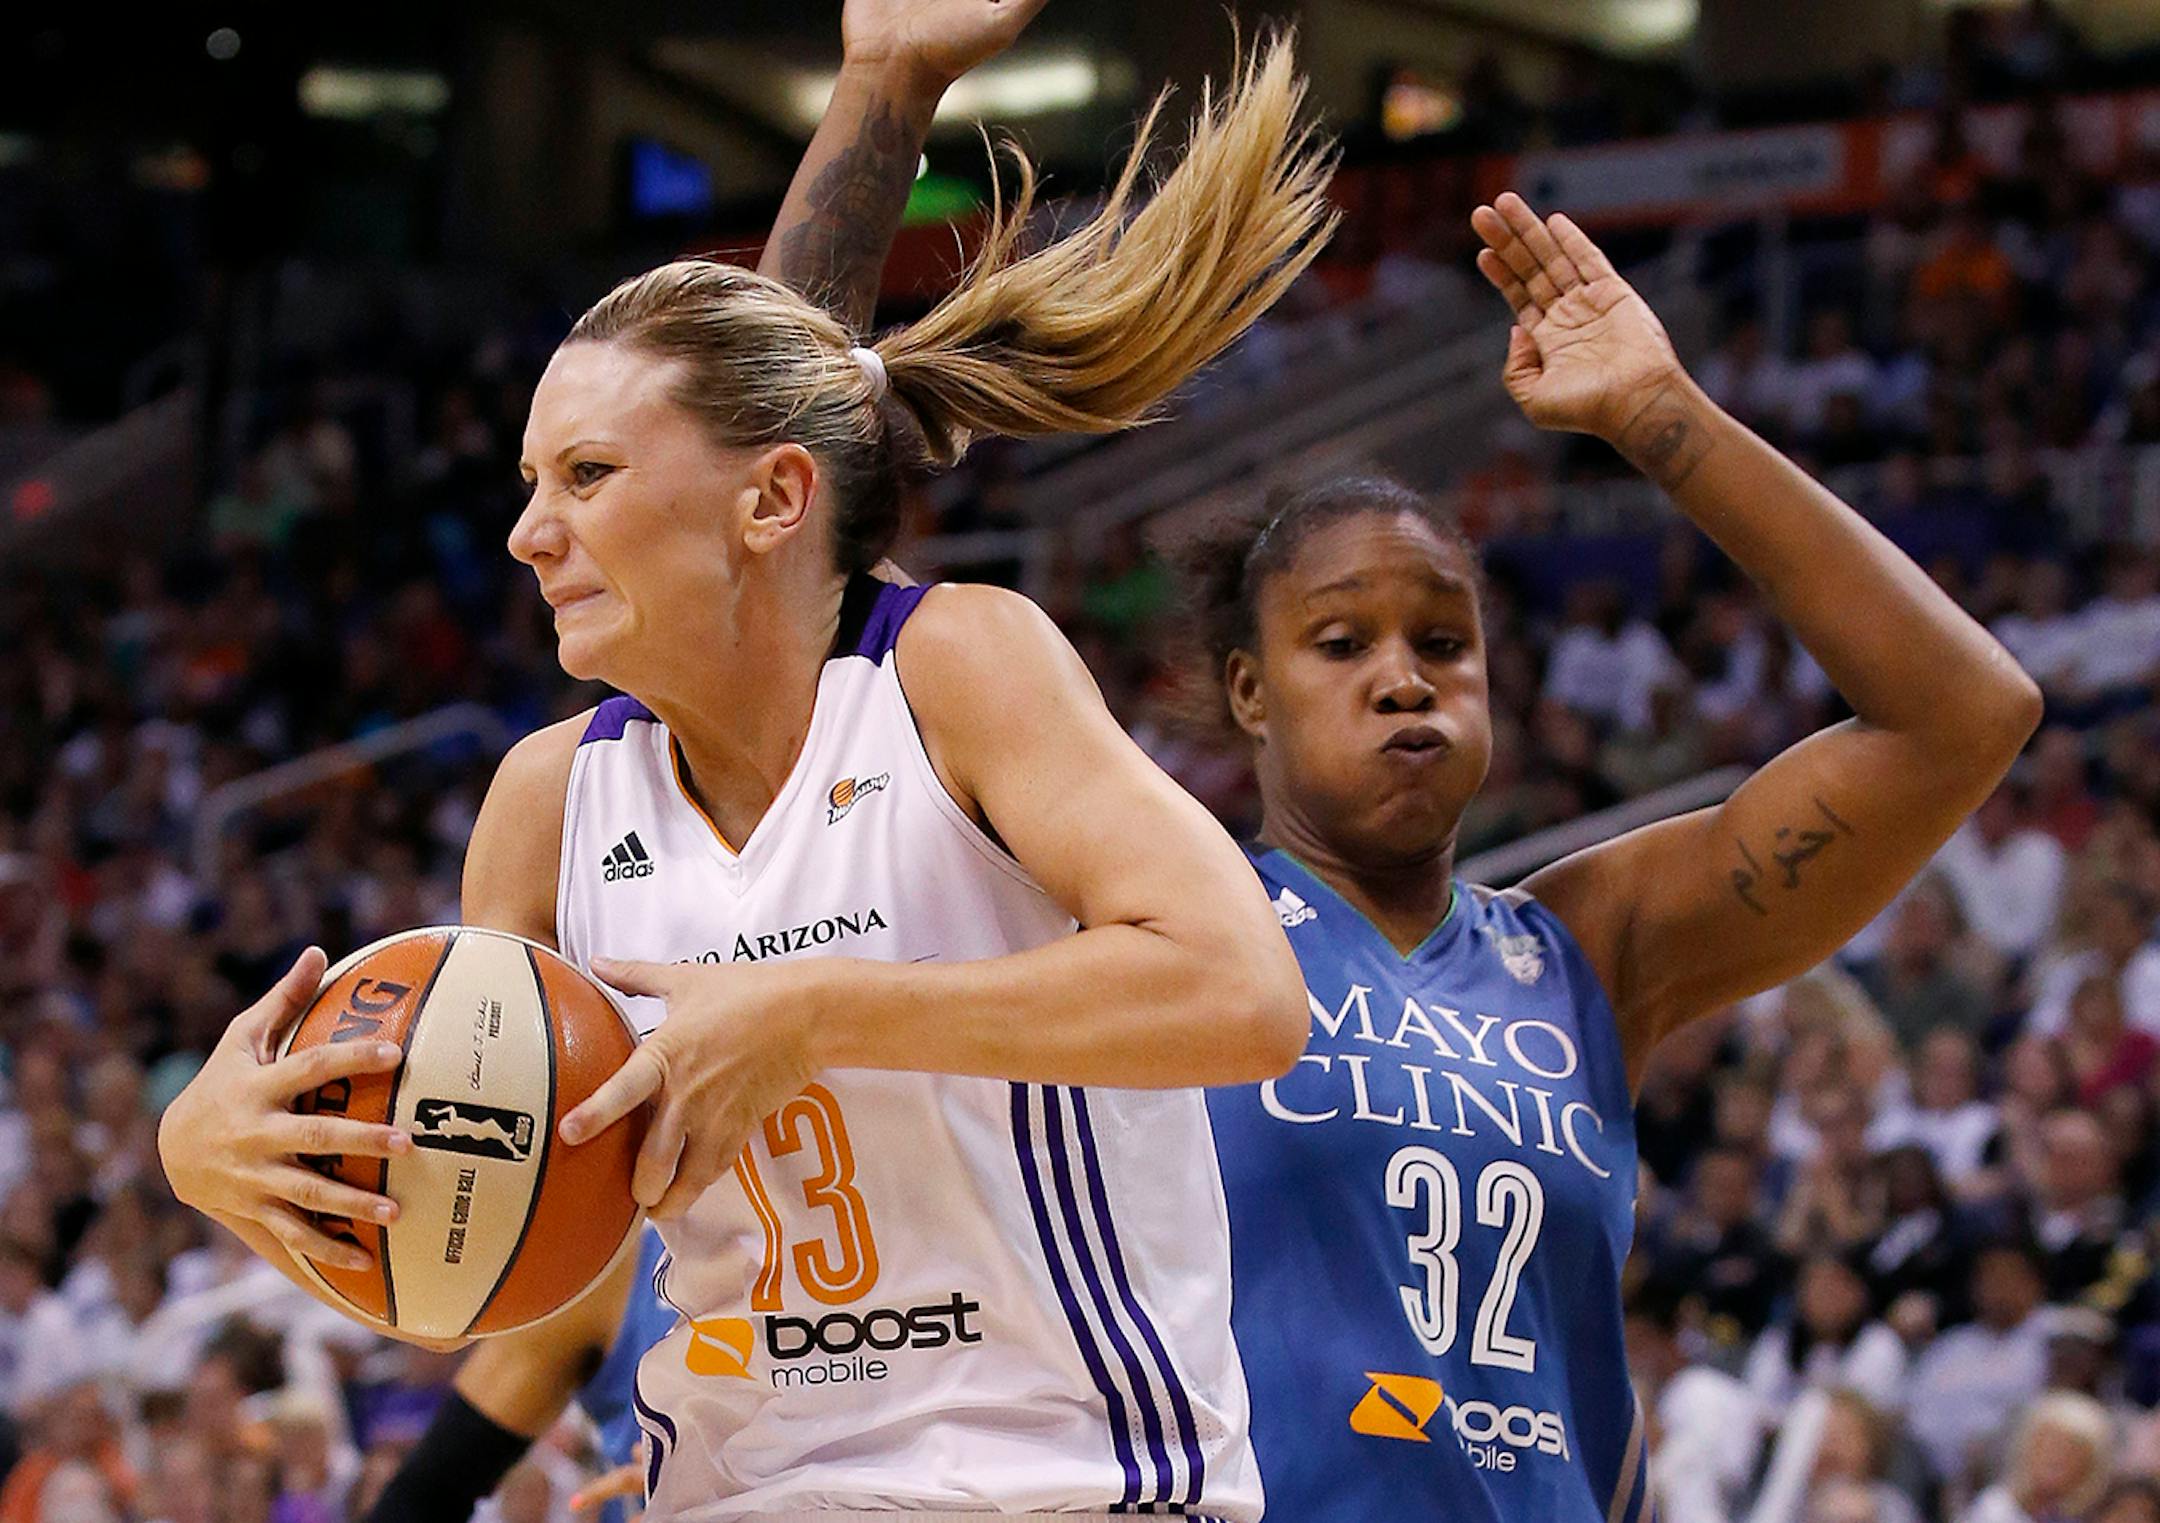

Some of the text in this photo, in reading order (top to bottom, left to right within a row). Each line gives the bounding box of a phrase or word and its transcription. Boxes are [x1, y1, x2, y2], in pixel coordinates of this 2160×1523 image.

[603, 860, 655, 882] adidas
[731, 907, 888, 963] ARIZONA
[1307, 983, 1579, 1080] MAYO
[1260, 1054, 1612, 1178] CLINIC
[733, 1082, 880, 1312] 13
[1384, 1145, 1545, 1374] 32
[765, 1292, 984, 1360] boost
[770, 1356, 889, 1388] mobile
